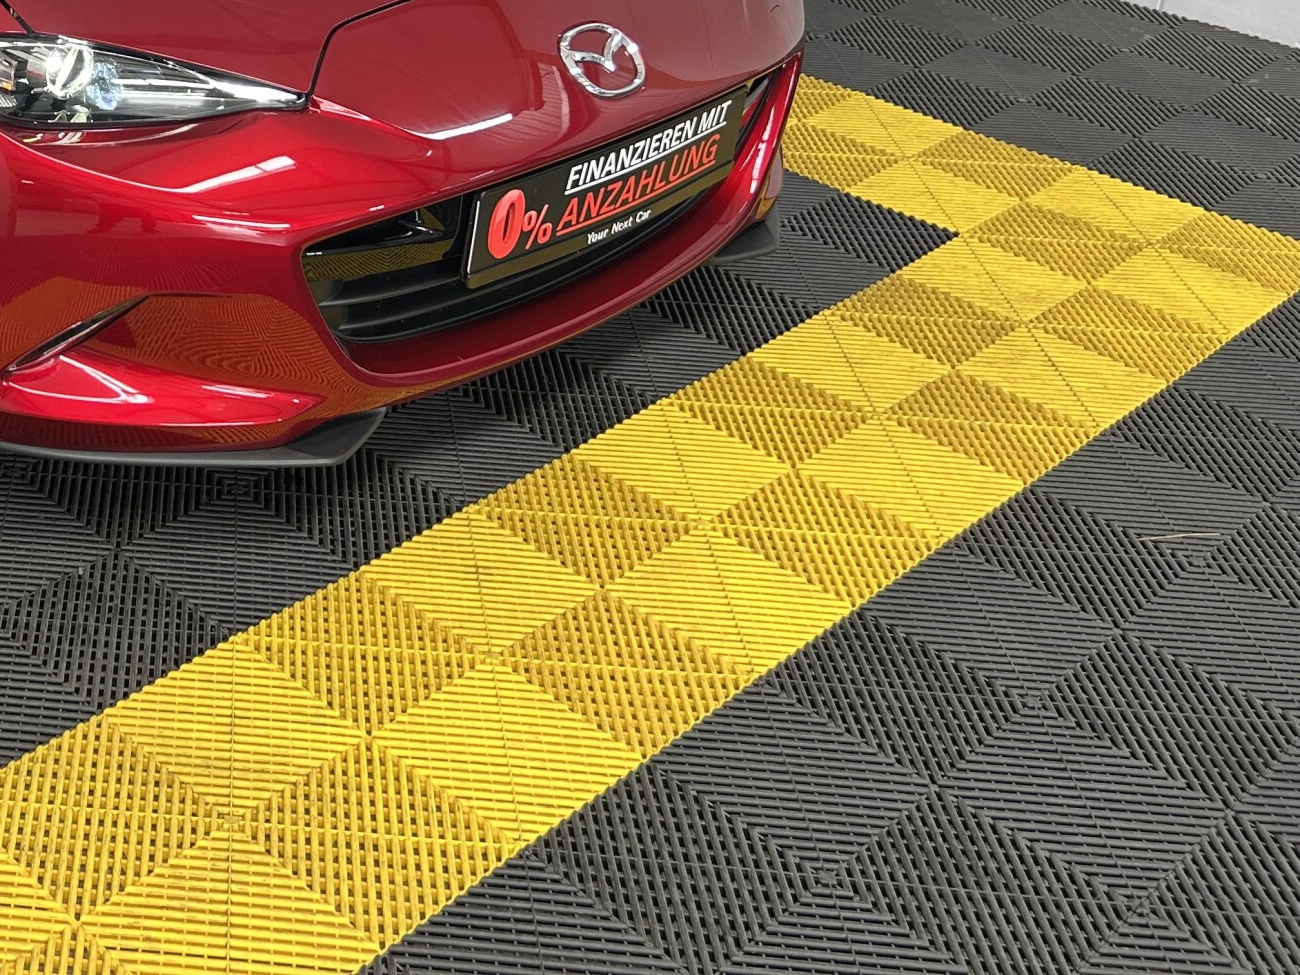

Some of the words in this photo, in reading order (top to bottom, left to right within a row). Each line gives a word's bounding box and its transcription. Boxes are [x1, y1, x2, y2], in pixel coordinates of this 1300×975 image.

[566, 116, 698, 191] FINANZIEREN
[697, 100, 732, 134] MIT
[487, 188, 553, 259] 0%
[556, 133, 720, 231] ANZAHLUNG
[587, 226, 609, 244] Your
[611, 216, 633, 234] Next
[636, 209, 651, 223] Car
